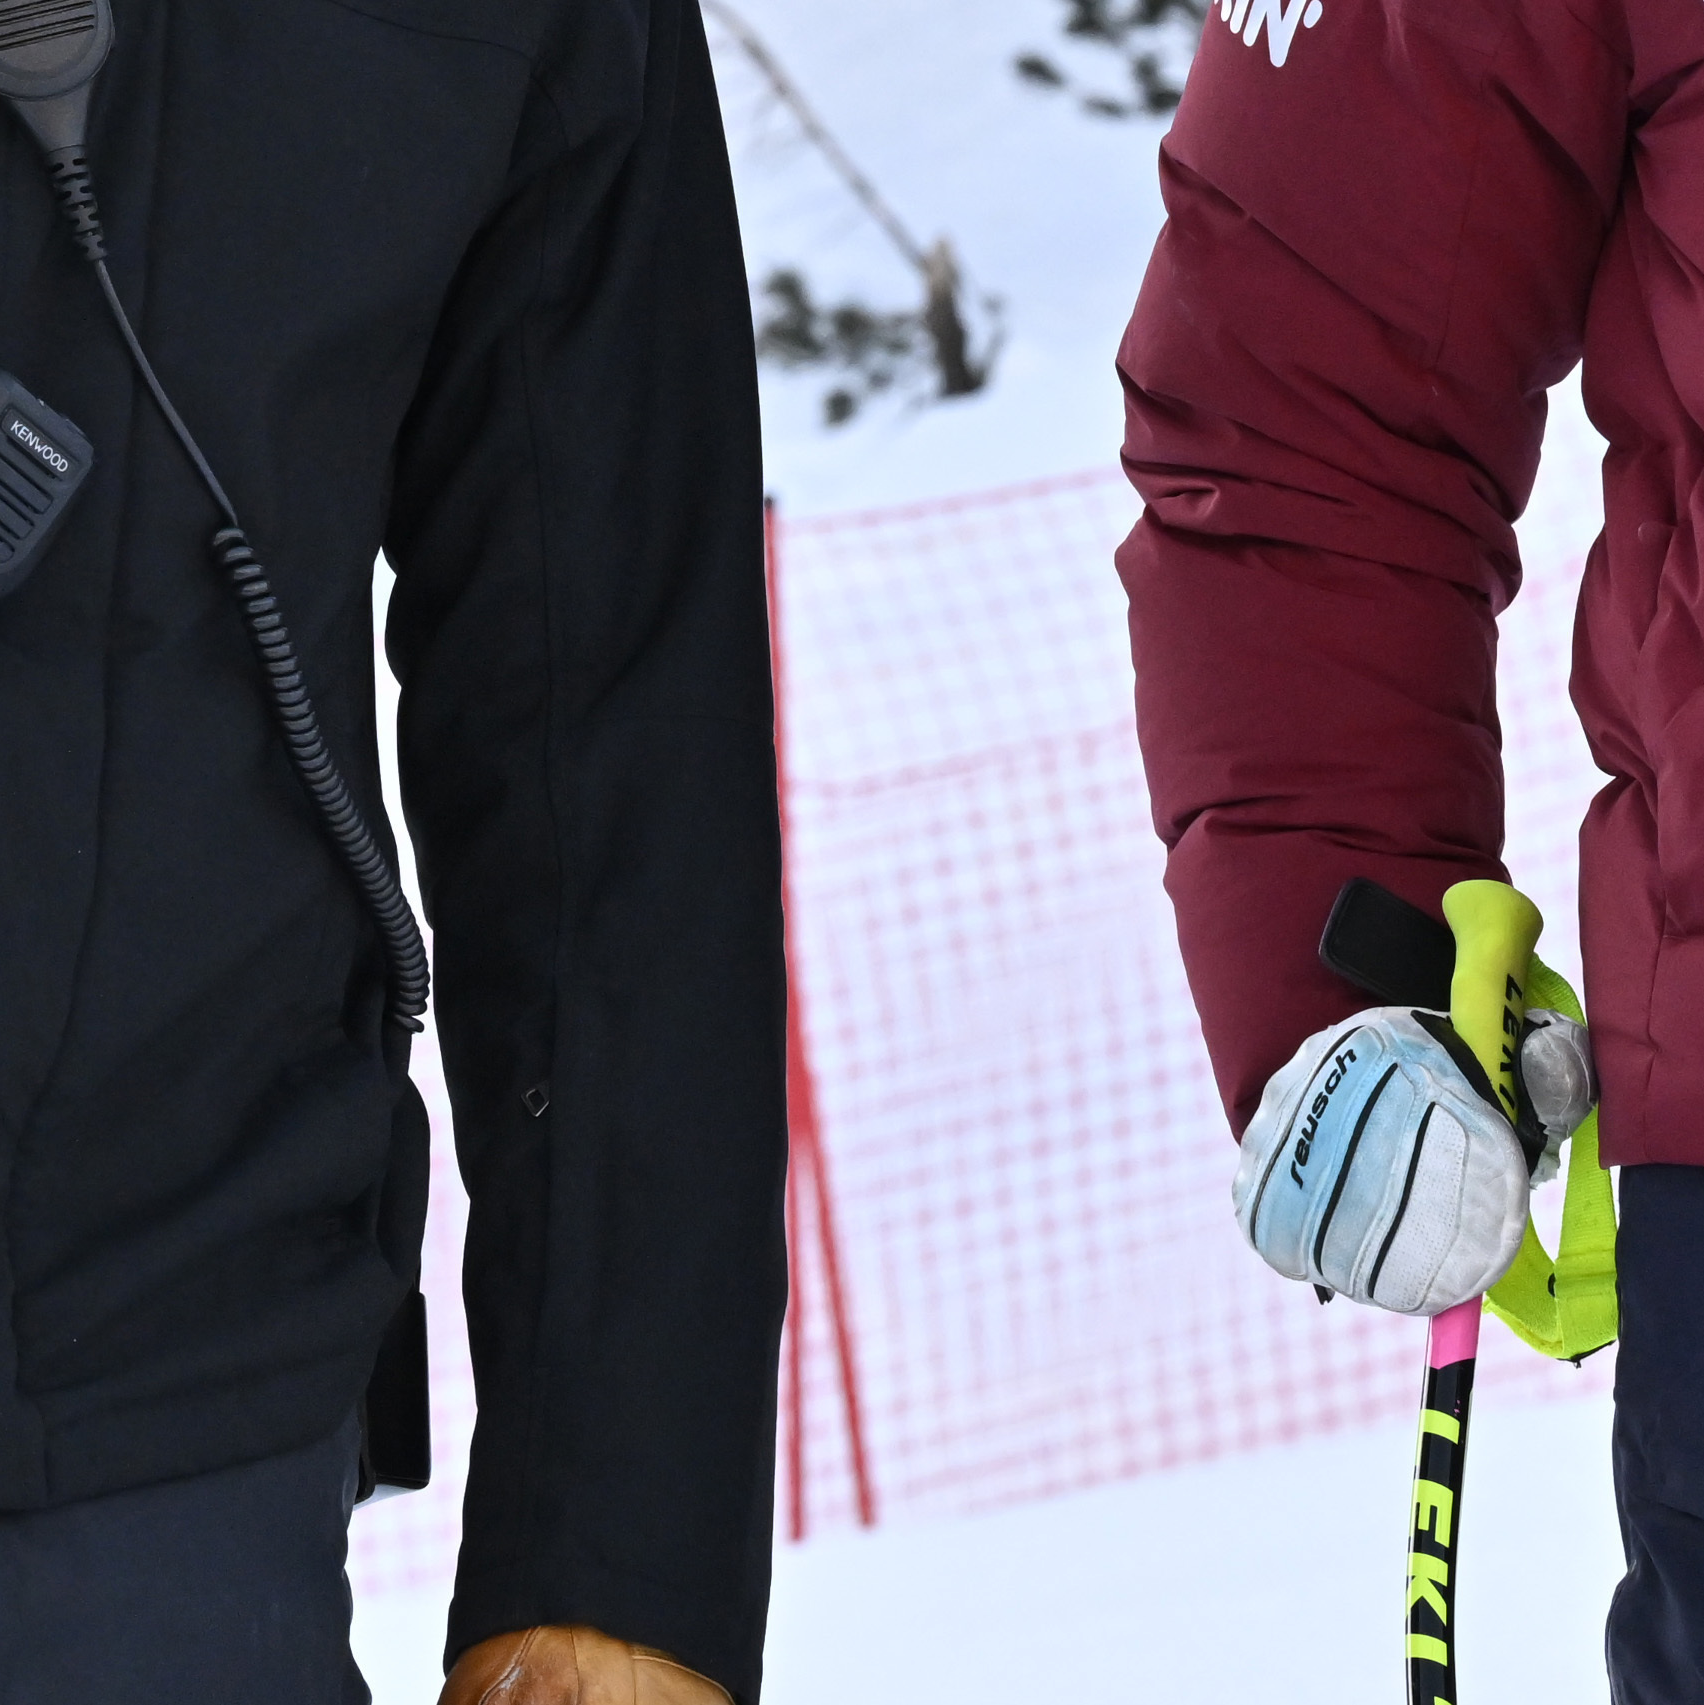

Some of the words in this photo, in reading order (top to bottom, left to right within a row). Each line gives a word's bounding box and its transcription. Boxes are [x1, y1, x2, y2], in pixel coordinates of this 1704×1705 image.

[10, 419, 69, 473] KENWOOD
[1290, 1047, 1358, 1191] reusch
[1405, 1408, 1461, 1668] LEKI
